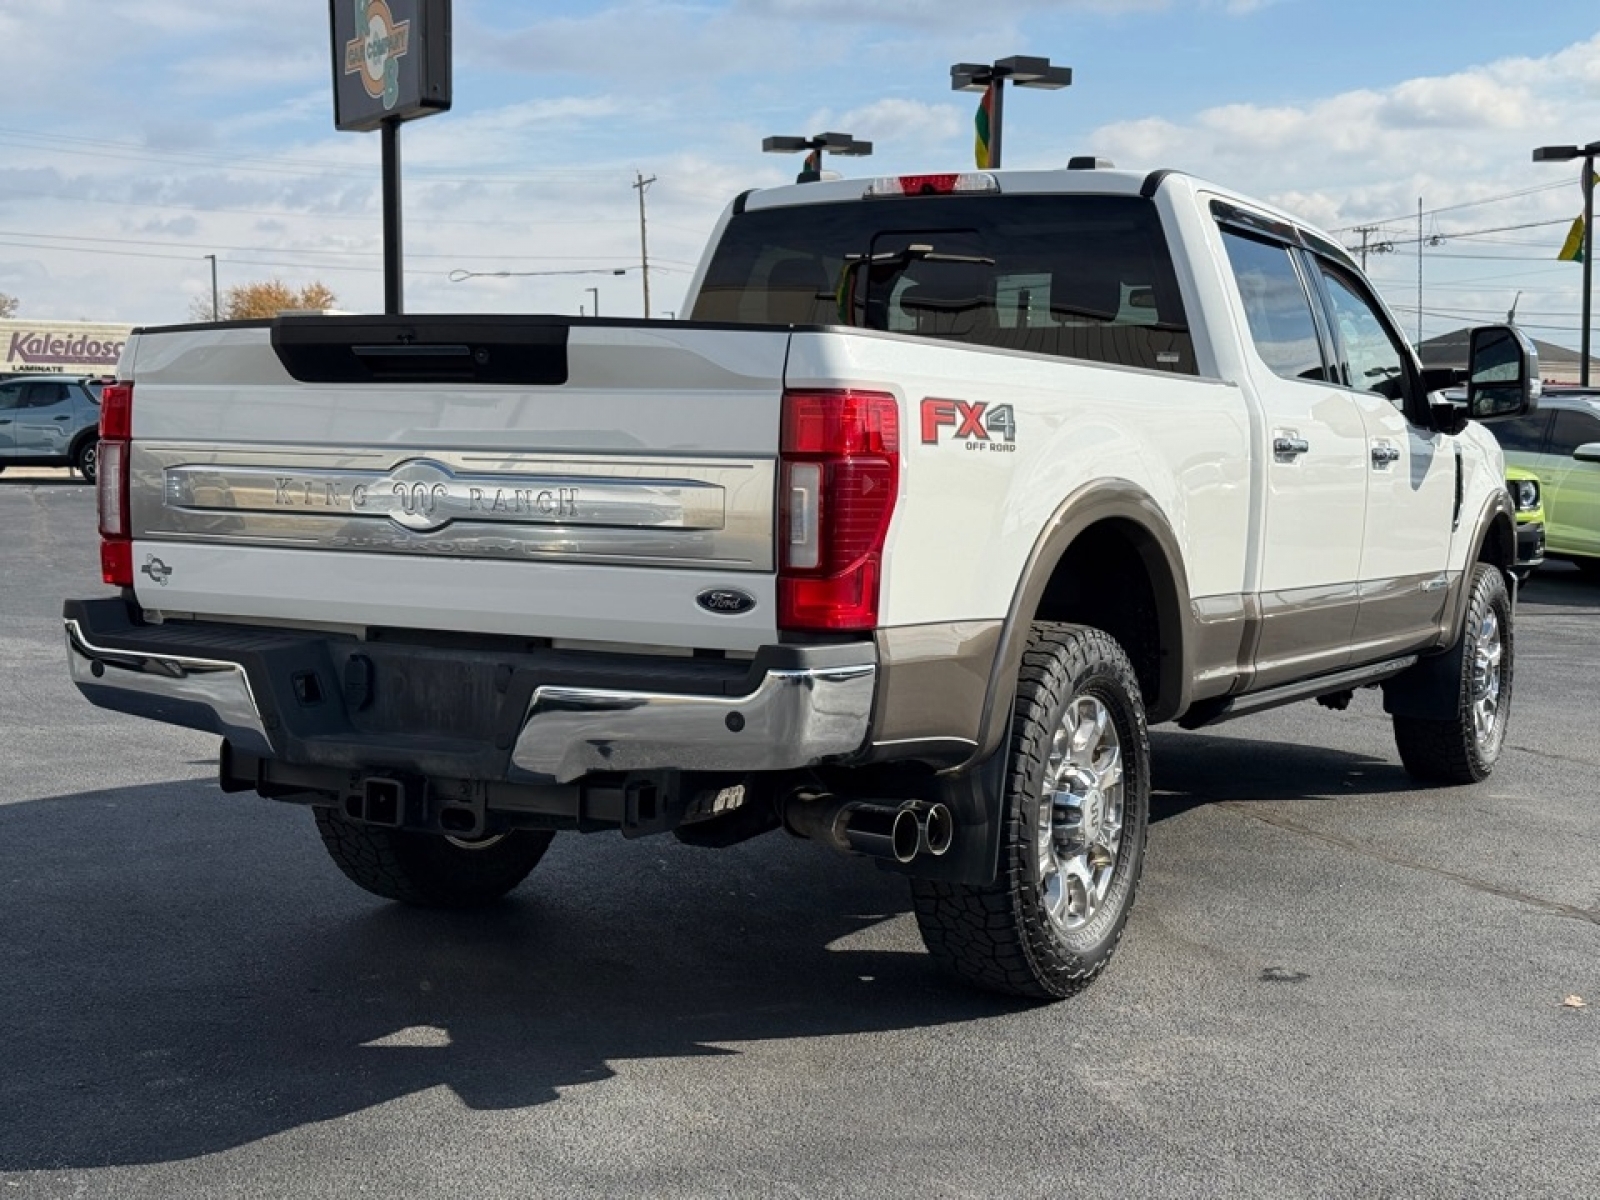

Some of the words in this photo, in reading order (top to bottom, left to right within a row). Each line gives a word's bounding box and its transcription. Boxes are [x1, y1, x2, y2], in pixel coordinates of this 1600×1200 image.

[12, 365, 63, 373] LAMINATE
[920, 397, 1016, 445] FX4
[965, 441, 985, 451] OFF
[990, 443, 1016, 453] ROAD
[274, 477, 369, 507] KING
[468, 487, 579, 517] RANCH
[708, 592, 741, 609] Ford
